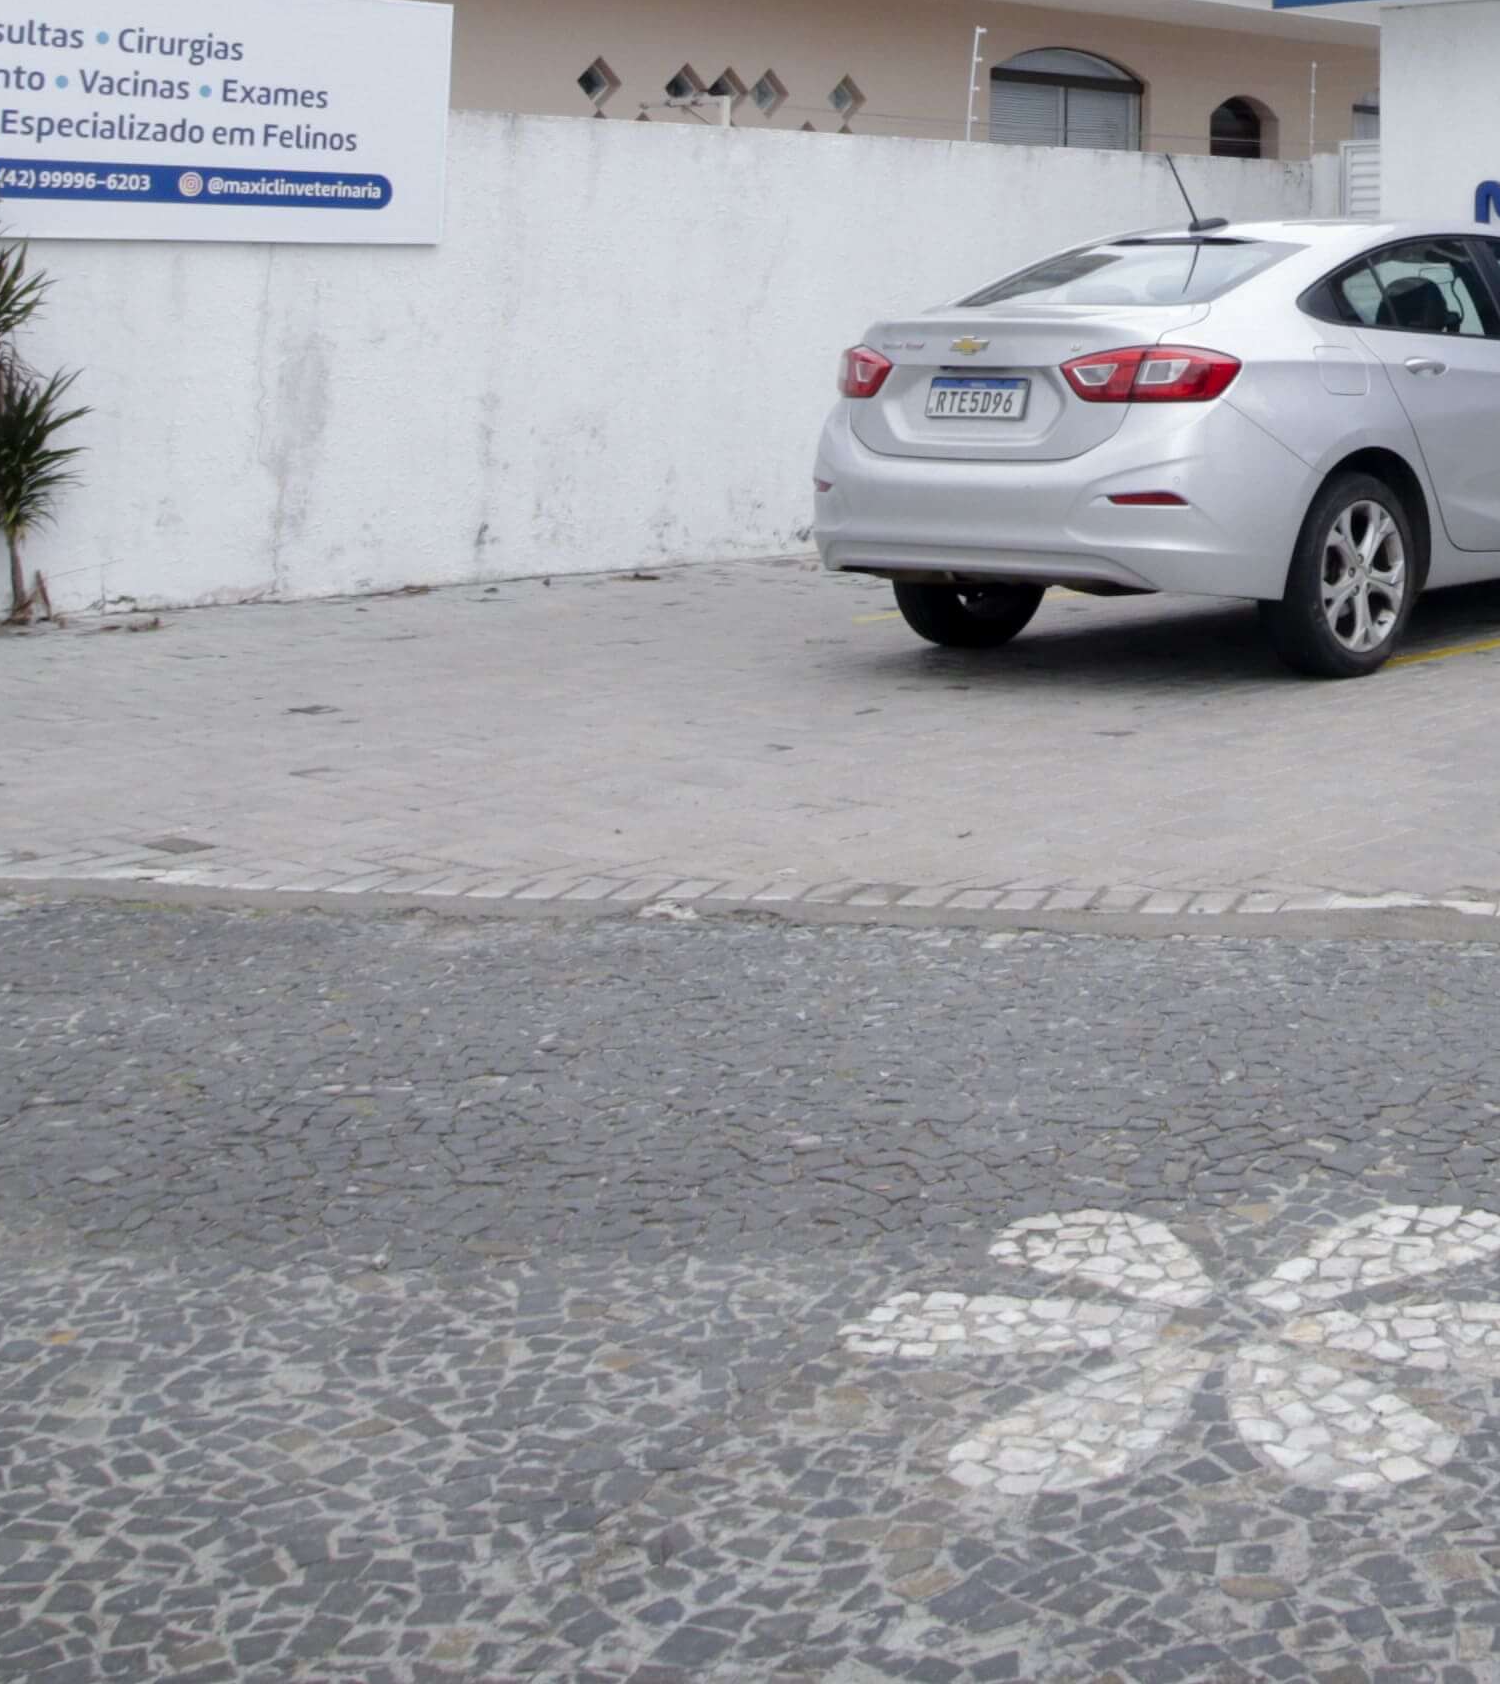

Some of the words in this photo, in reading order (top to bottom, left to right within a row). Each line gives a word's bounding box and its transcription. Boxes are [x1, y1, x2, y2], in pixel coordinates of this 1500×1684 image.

[118, 27, 244, 66] Cirurgias
[79, 69, 190, 100] Vacinas
[222, 79, 329, 109] Exames
[1, 109, 205, 144] Especializado
[212, 127, 255, 147] em
[263, 124, 357, 152] Felinos
[38, 171, 151, 192] 99996-6203
[207, 176, 382, 200] @maxiclinveterinaria
[934, 390, 1015, 414] RTE5D96
